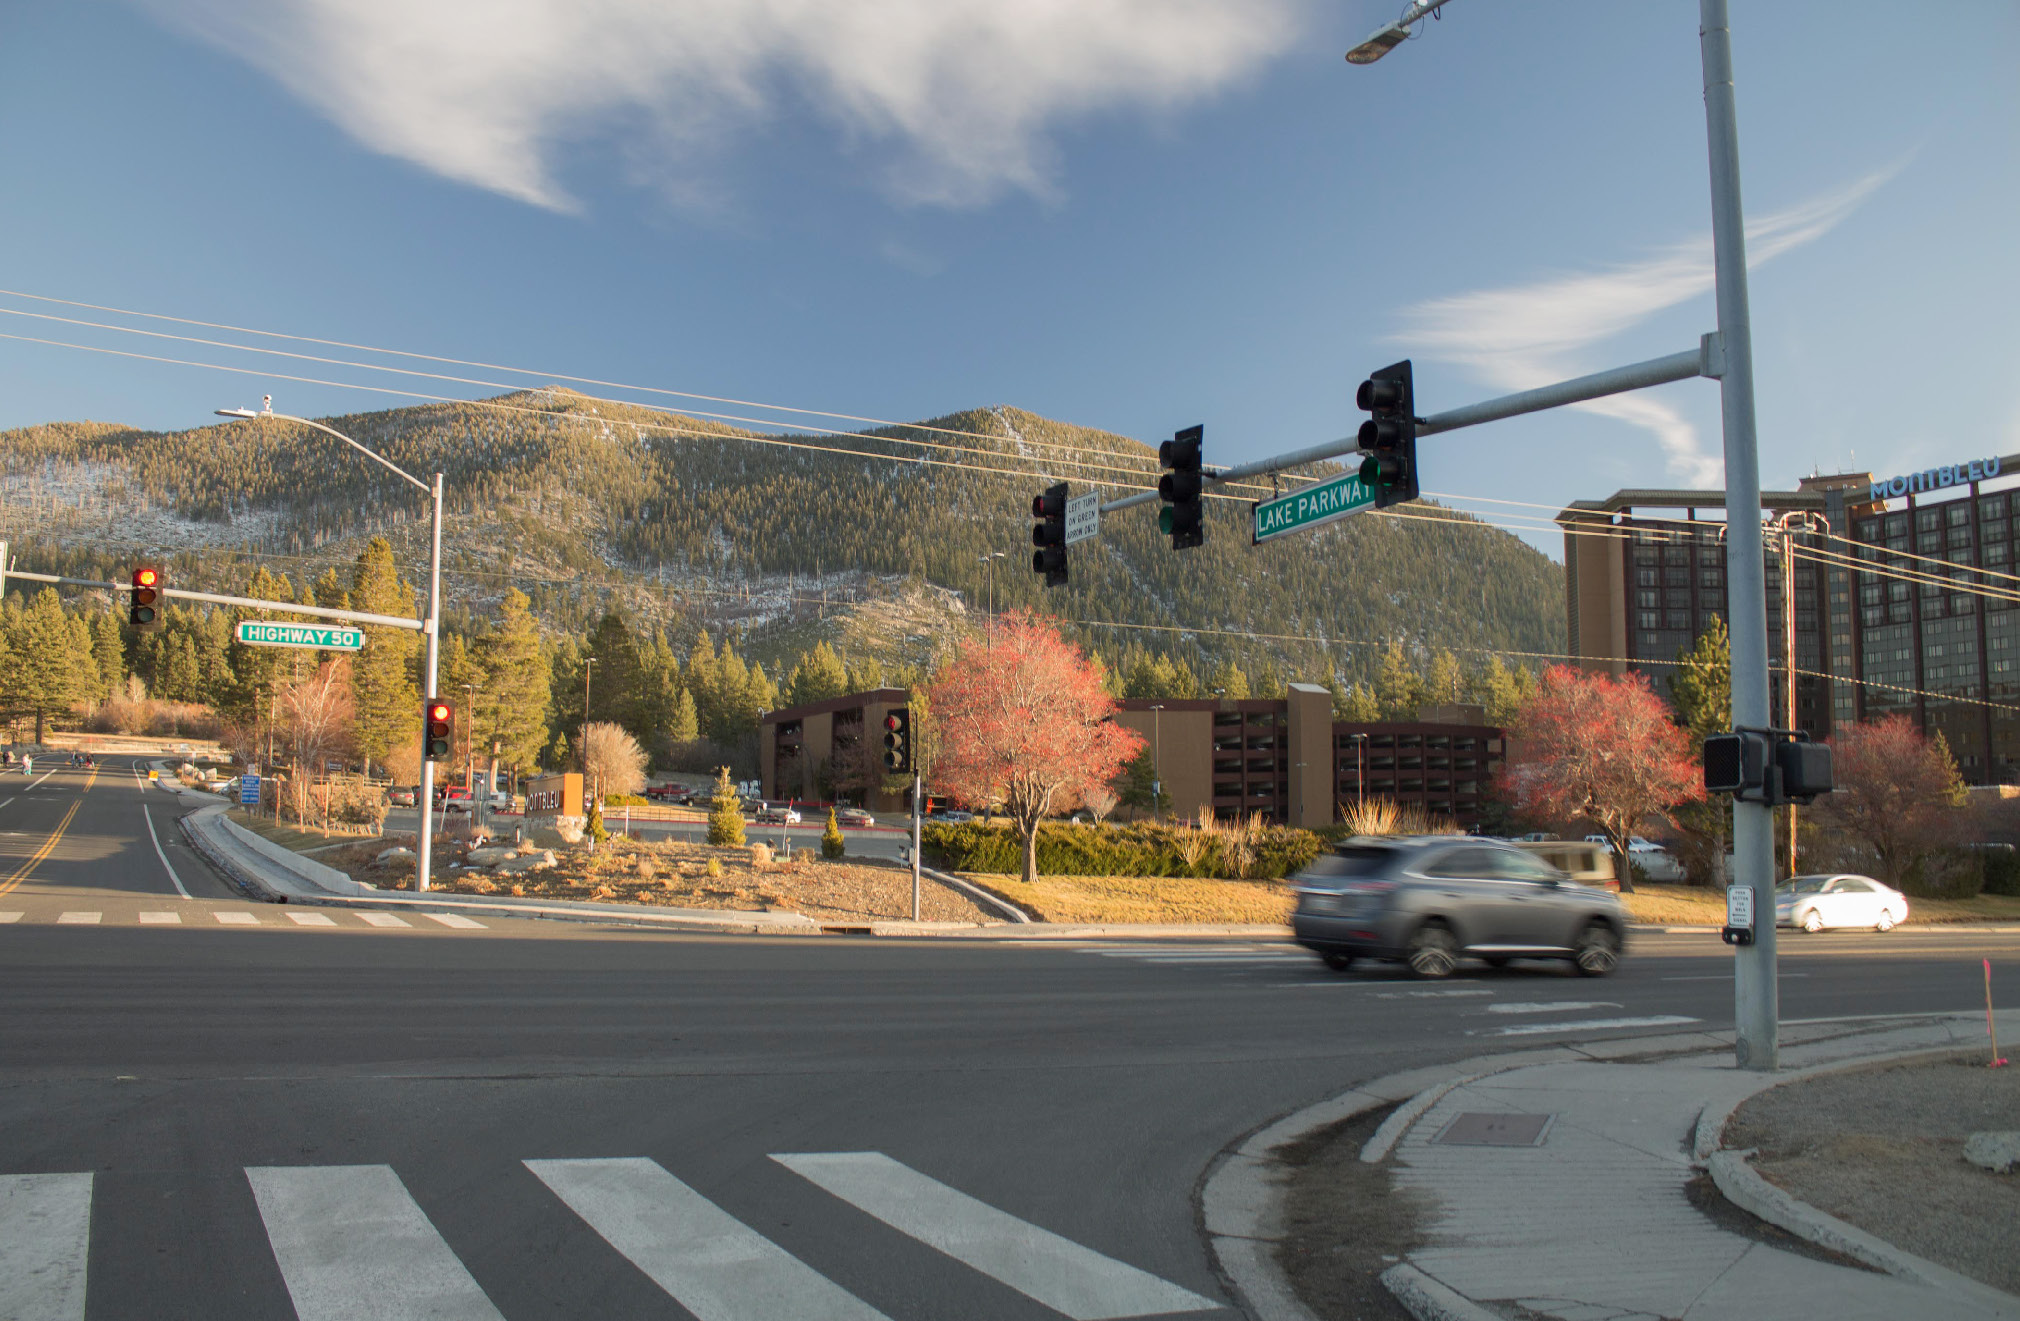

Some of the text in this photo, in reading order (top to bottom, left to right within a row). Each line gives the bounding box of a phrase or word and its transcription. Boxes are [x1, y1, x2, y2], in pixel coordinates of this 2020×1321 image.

[1870, 456, 2000, 500] MONTBLEU
[1068, 495, 1097, 513] LEFT TURN
[1068, 510, 1096, 526] ON GREEN
[1259, 502, 1293, 532] LAKE
[248, 626, 354, 646] HIGHWAY 50
[525, 790, 560, 811] MONTBLEU
